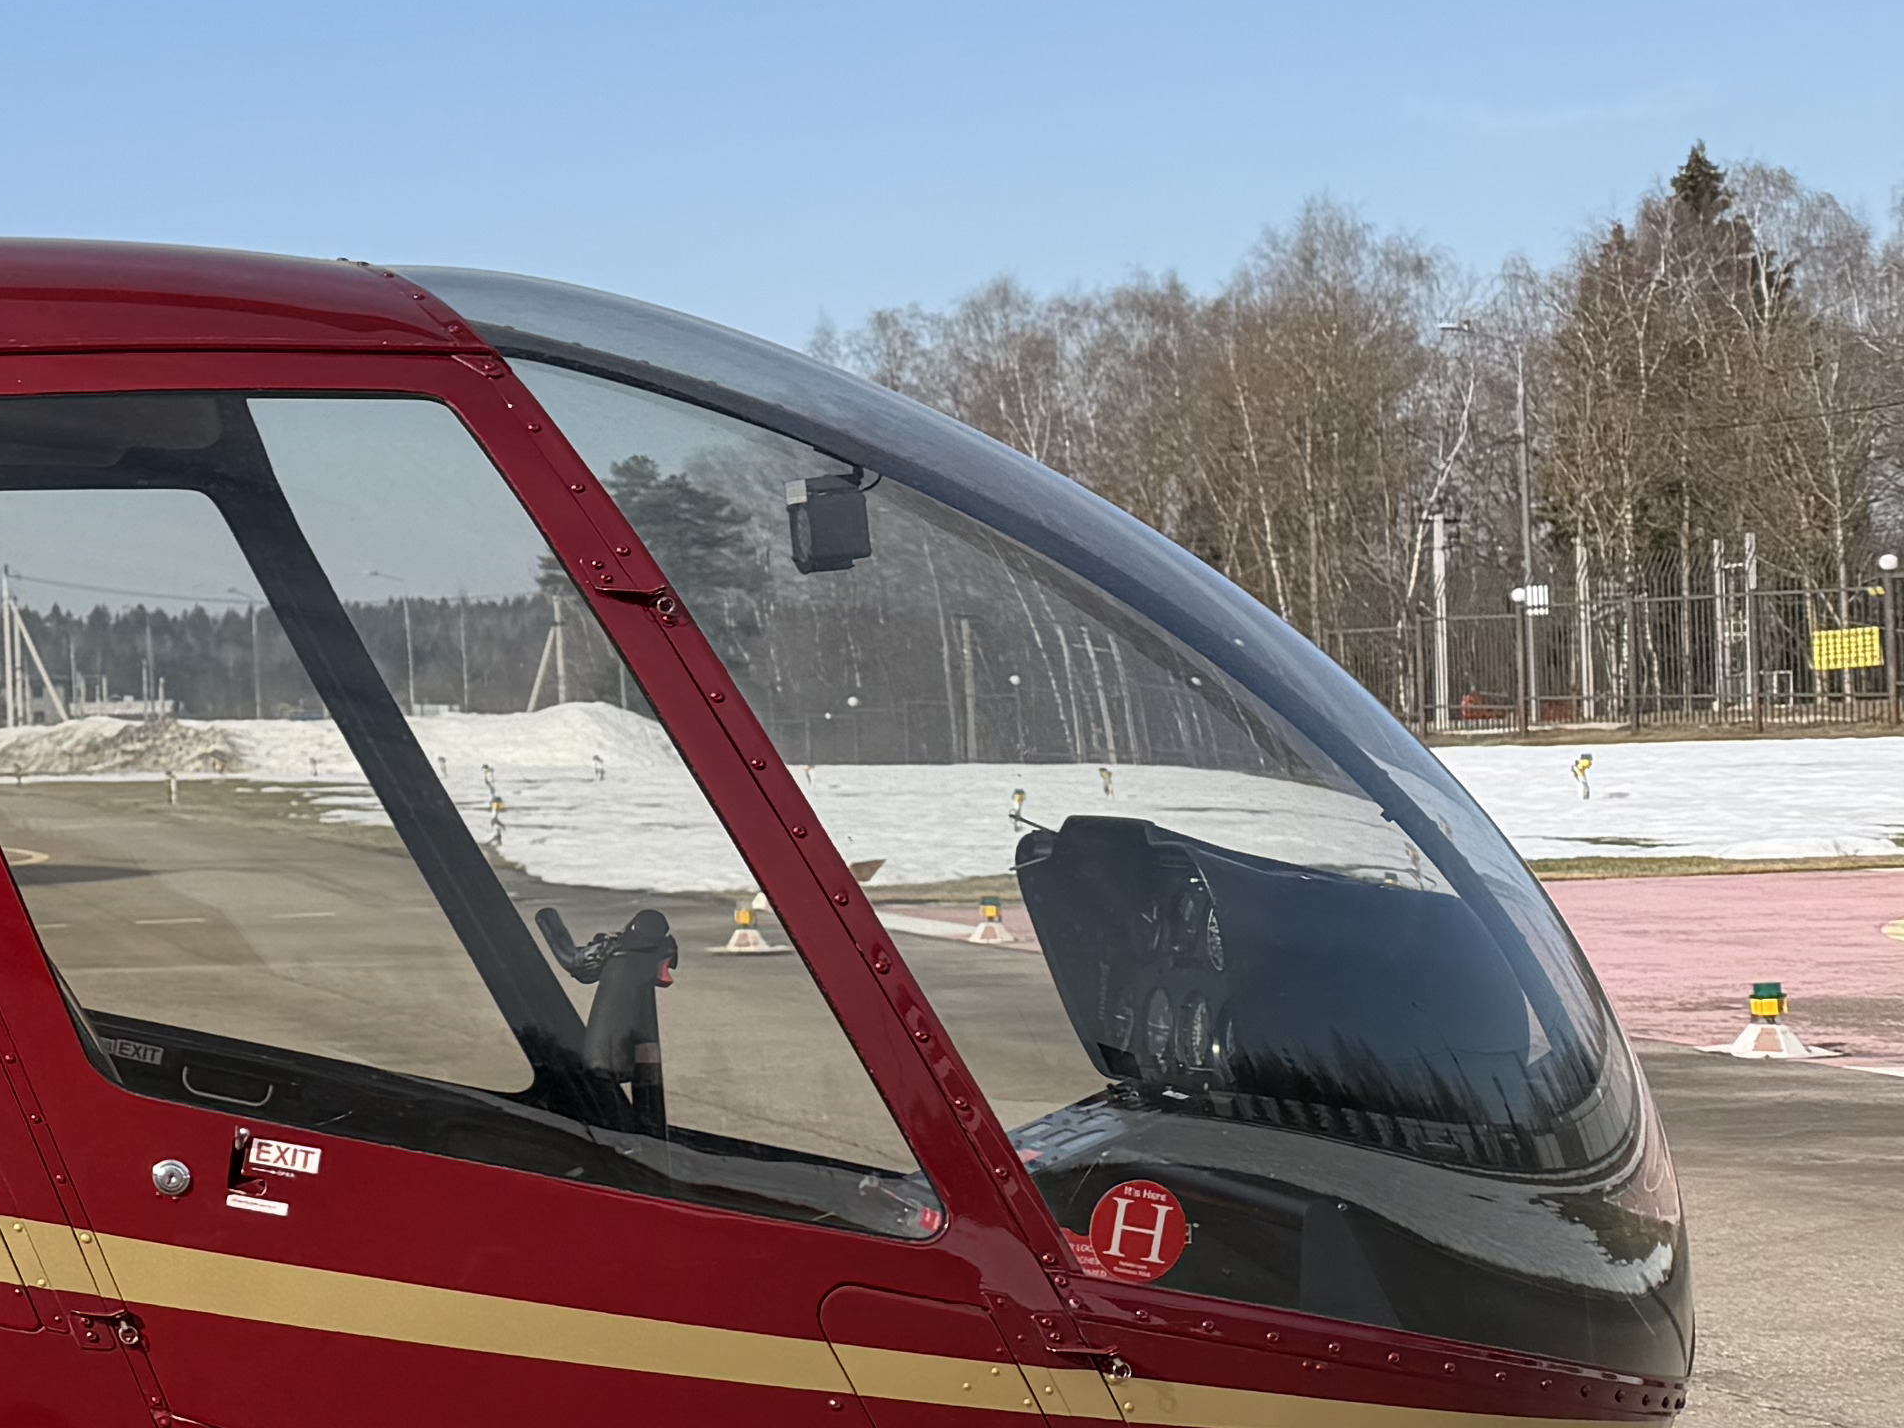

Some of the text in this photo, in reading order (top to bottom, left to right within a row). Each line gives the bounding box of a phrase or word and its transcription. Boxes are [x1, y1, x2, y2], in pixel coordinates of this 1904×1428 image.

[118, 1042, 160, 1062] EXIT
[255, 1141, 316, 1170] EXIT
[1102, 1197, 1173, 1264] H
